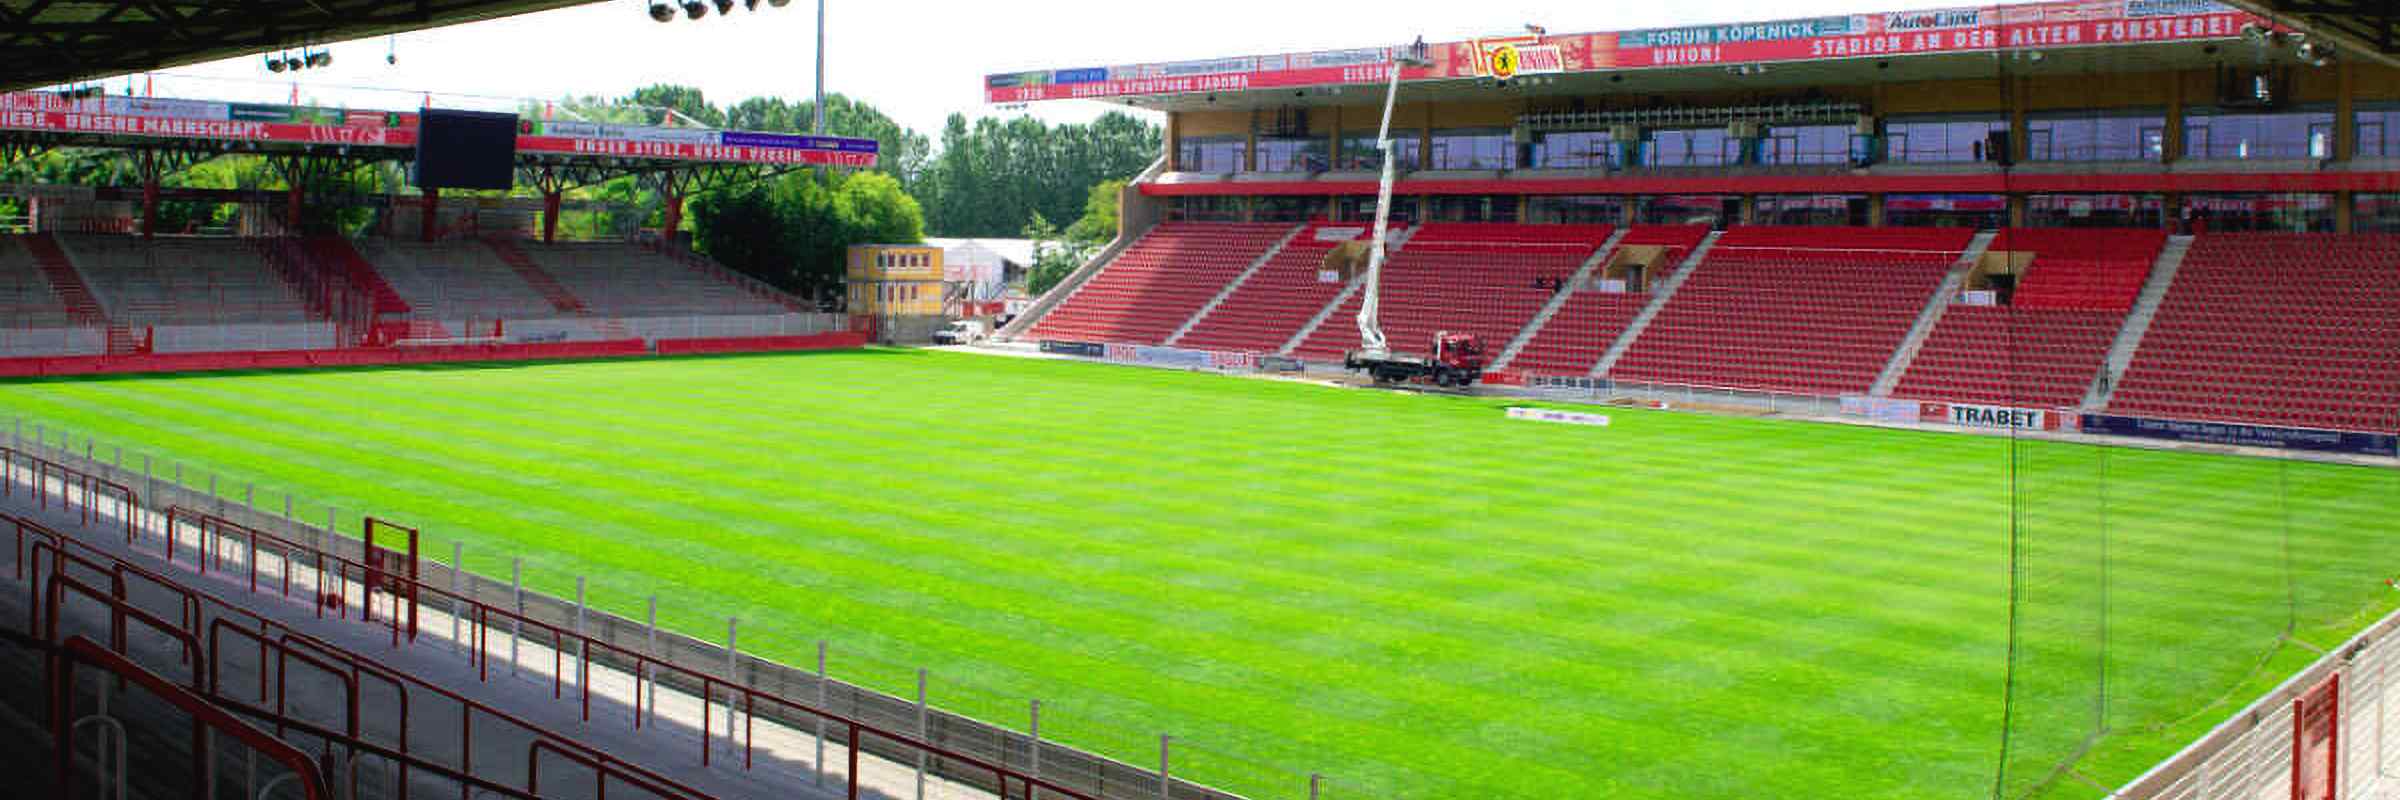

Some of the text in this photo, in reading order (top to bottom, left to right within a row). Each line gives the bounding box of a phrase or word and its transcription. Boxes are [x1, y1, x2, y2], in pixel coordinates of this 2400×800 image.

[1647, 27, 1710, 46] FORUM
[1813, 34, 1901, 56] STADION
[1914, 33, 1940, 50] AN
[1954, 30, 1995, 49] DER
[2009, 24, 2080, 46] ALTEN
[1653, 44, 1721, 64] UNION!
[1951, 405, 2035, 428] TRABET
